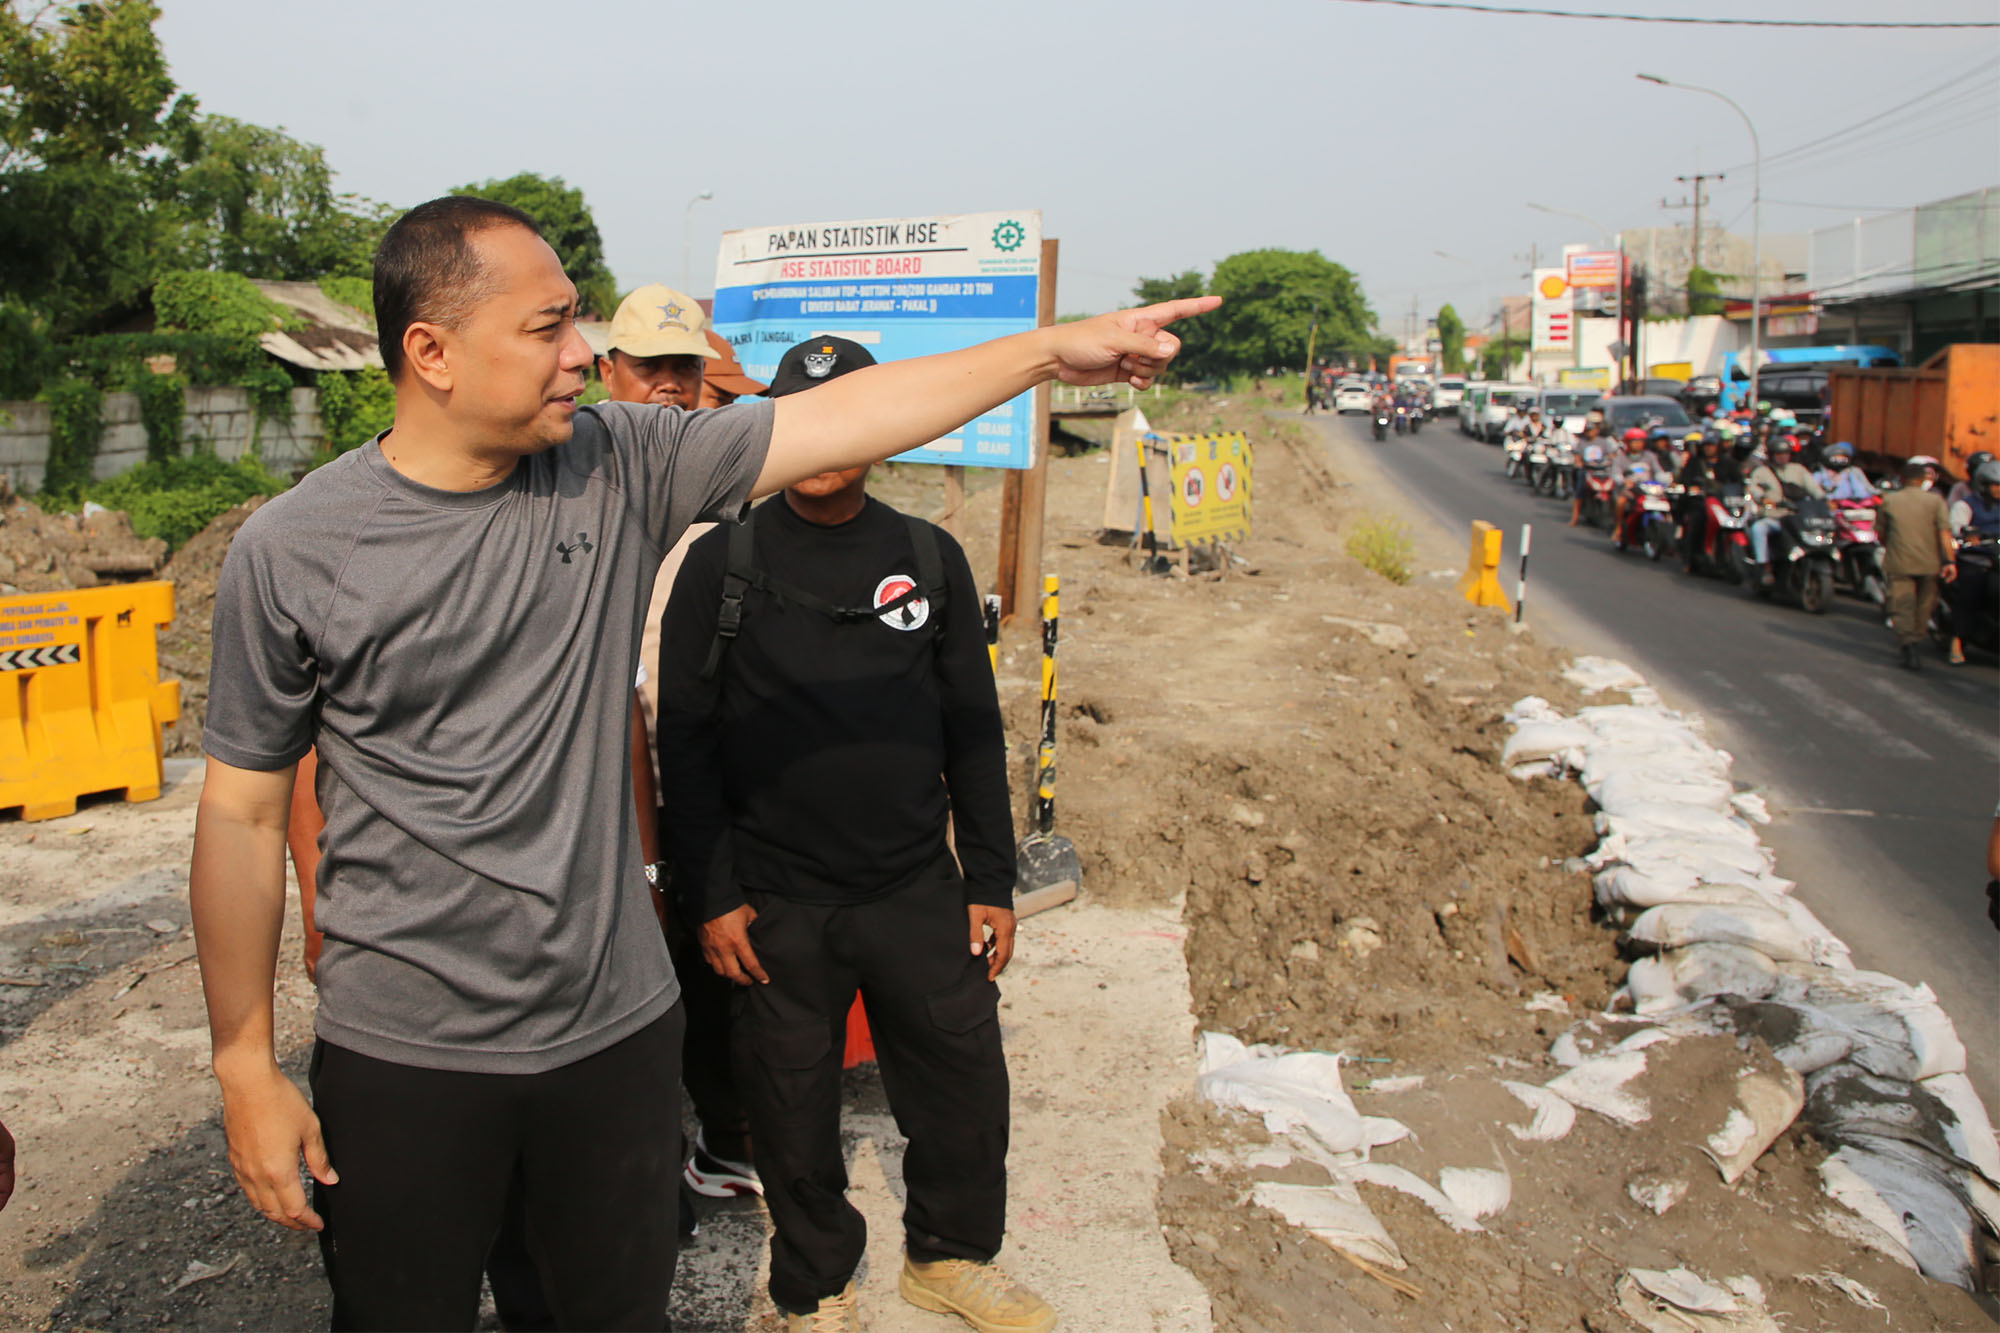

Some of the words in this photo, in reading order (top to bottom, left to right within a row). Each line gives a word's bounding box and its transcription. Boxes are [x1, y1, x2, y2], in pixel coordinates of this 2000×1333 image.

[768, 229, 817, 252] PAPAN
[823, 224, 899, 248] STATISTIK
[906, 222, 938, 244] HSE
[781, 261, 806, 279] HSE
[809, 258, 872, 278] STATISTIC
[876, 256, 922, 276] BOARD
